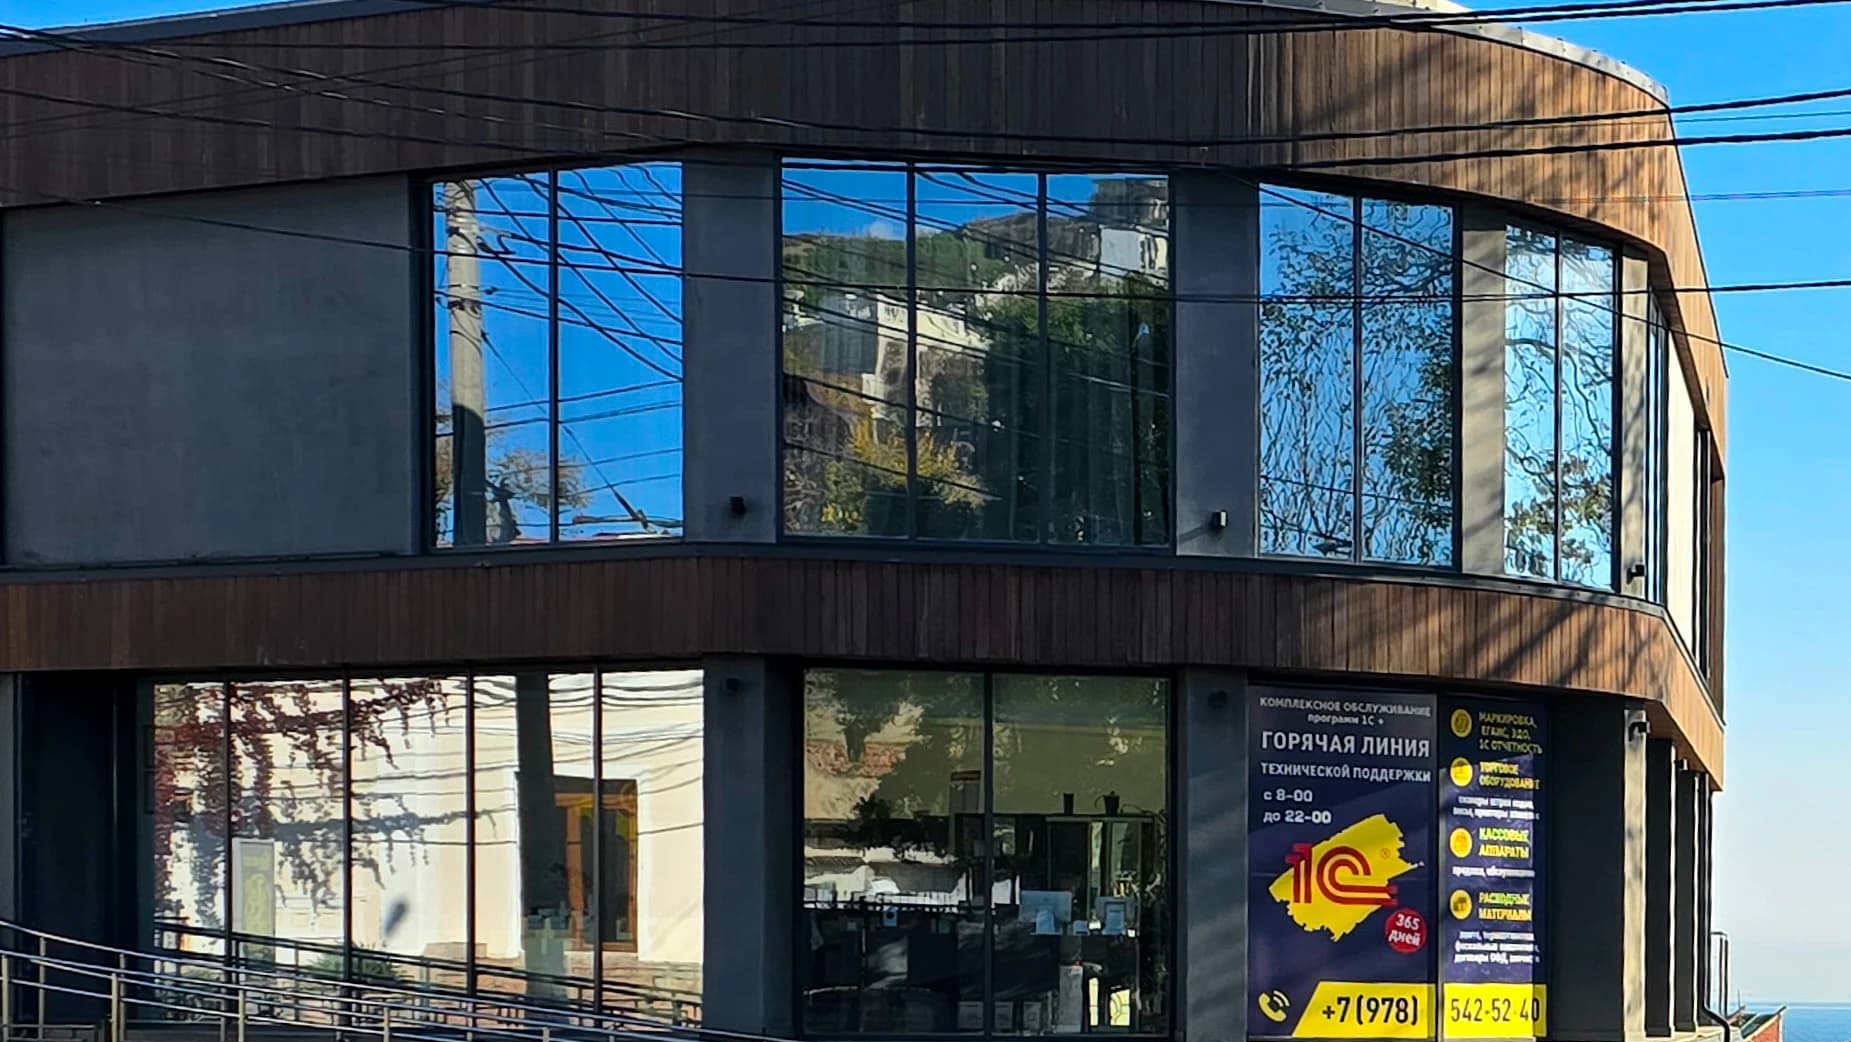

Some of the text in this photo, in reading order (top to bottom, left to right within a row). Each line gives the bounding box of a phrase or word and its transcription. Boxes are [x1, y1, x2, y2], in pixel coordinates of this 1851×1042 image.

[1260, 697, 1431, 717] КОМПЛЕКСНОЕ ОБСЛУЖИВАНИЕ
[1308, 714, 1359, 725] программ
[1261, 731, 1430, 758] ГОРЯЧАЯ ЛИНИЯ
[1261, 762, 1431, 782] ТЕХНИЧЕСКОЙ ПОДДЕРЖКИ
[1275, 789, 1313, 802] 8-00
[1263, 810, 1332, 823] до 22-00
[1479, 844, 1529, 859] АППАРАТЫ
[1395, 914, 1420, 931] 365
[1388, 930, 1421, 947] дней
